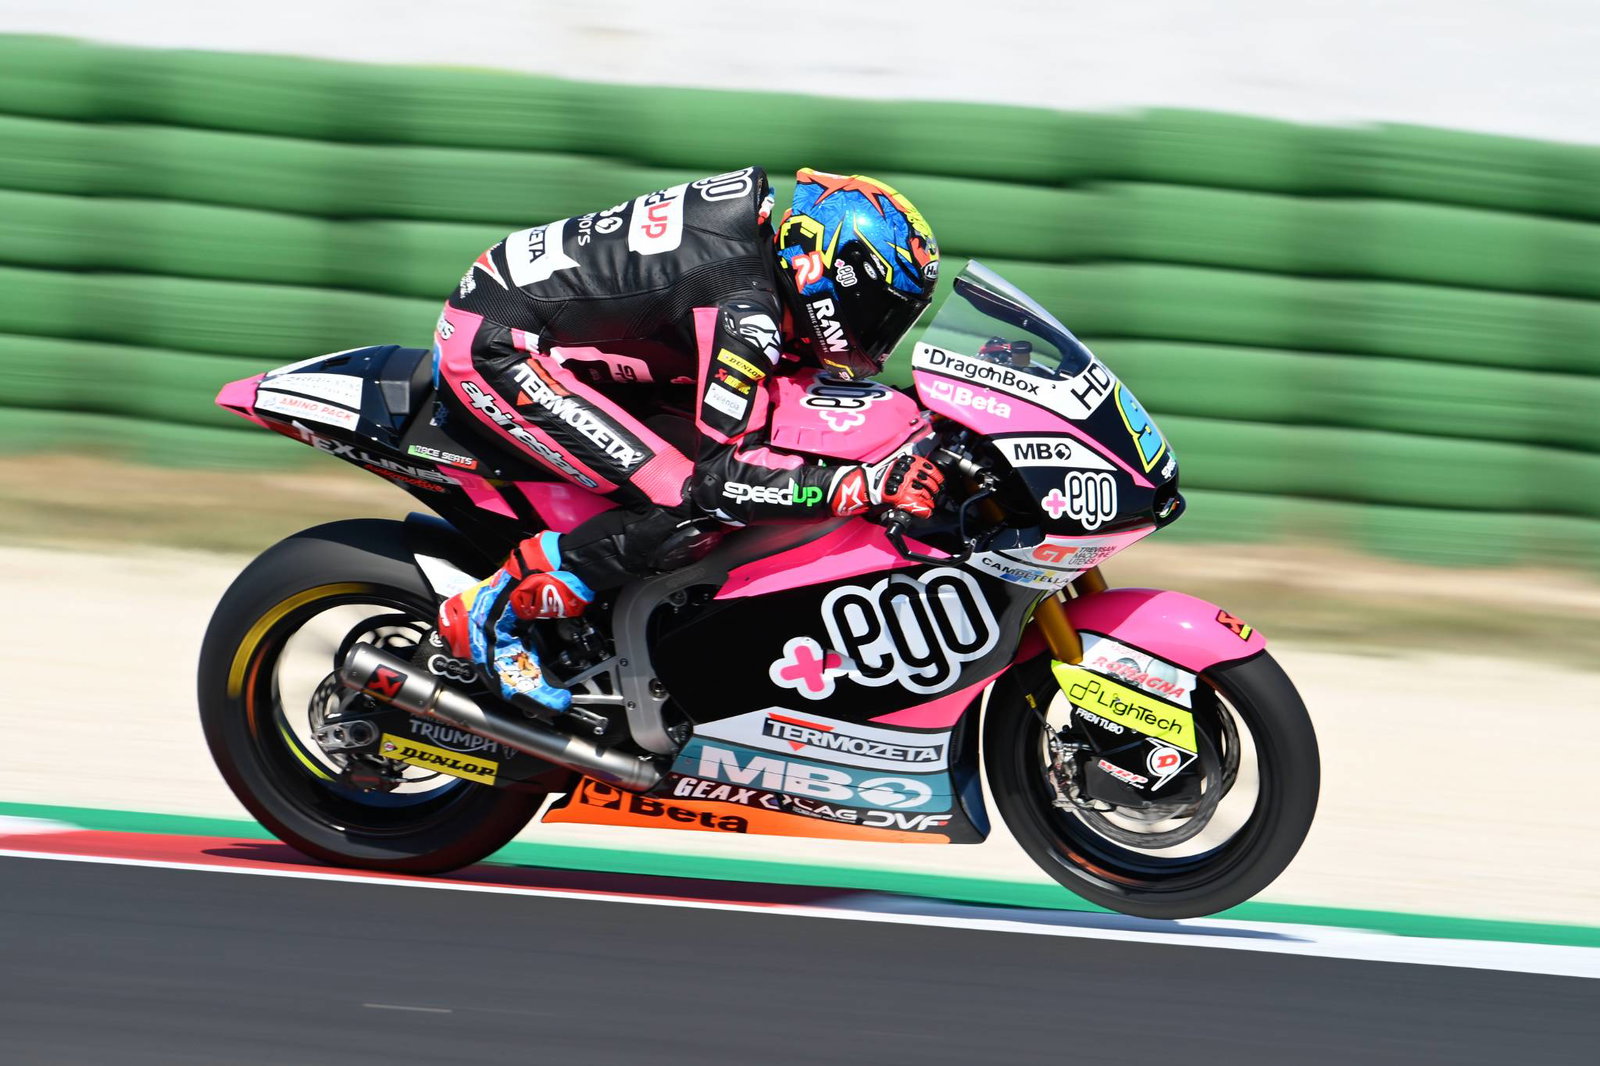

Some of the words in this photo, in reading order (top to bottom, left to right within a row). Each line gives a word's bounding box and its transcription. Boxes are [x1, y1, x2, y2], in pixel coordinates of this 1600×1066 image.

[812, 297, 849, 352] RAW
[728, 356, 763, 379] DUNLOP
[929, 348, 1040, 396] DragonBox
[279, 397, 318, 411] AMINO
[321, 406, 354, 421] PACK
[513, 362, 640, 469] TERMOZETA
[953, 386, 1012, 419] Beta
[460, 380, 598, 488] alpinestars
[1114, 379, 1167, 474] 9
[415, 445, 441, 458] RACE
[441, 451, 473, 466] SEATS
[1032, 544, 1081, 563] GT
[1092, 656, 1186, 698] ROMAGNA
[1097, 689, 1183, 734] LighTech
[1099, 718, 1125, 735] TUBO
[409, 719, 498, 753] TRIUMPH
[767, 719, 940, 762] TERMOZETA
[400, 746, 497, 777] DUNLOP
[673, 776, 758, 805] GEAX
[629, 796, 749, 834] Beta
[862, 810, 952, 831] DVF
